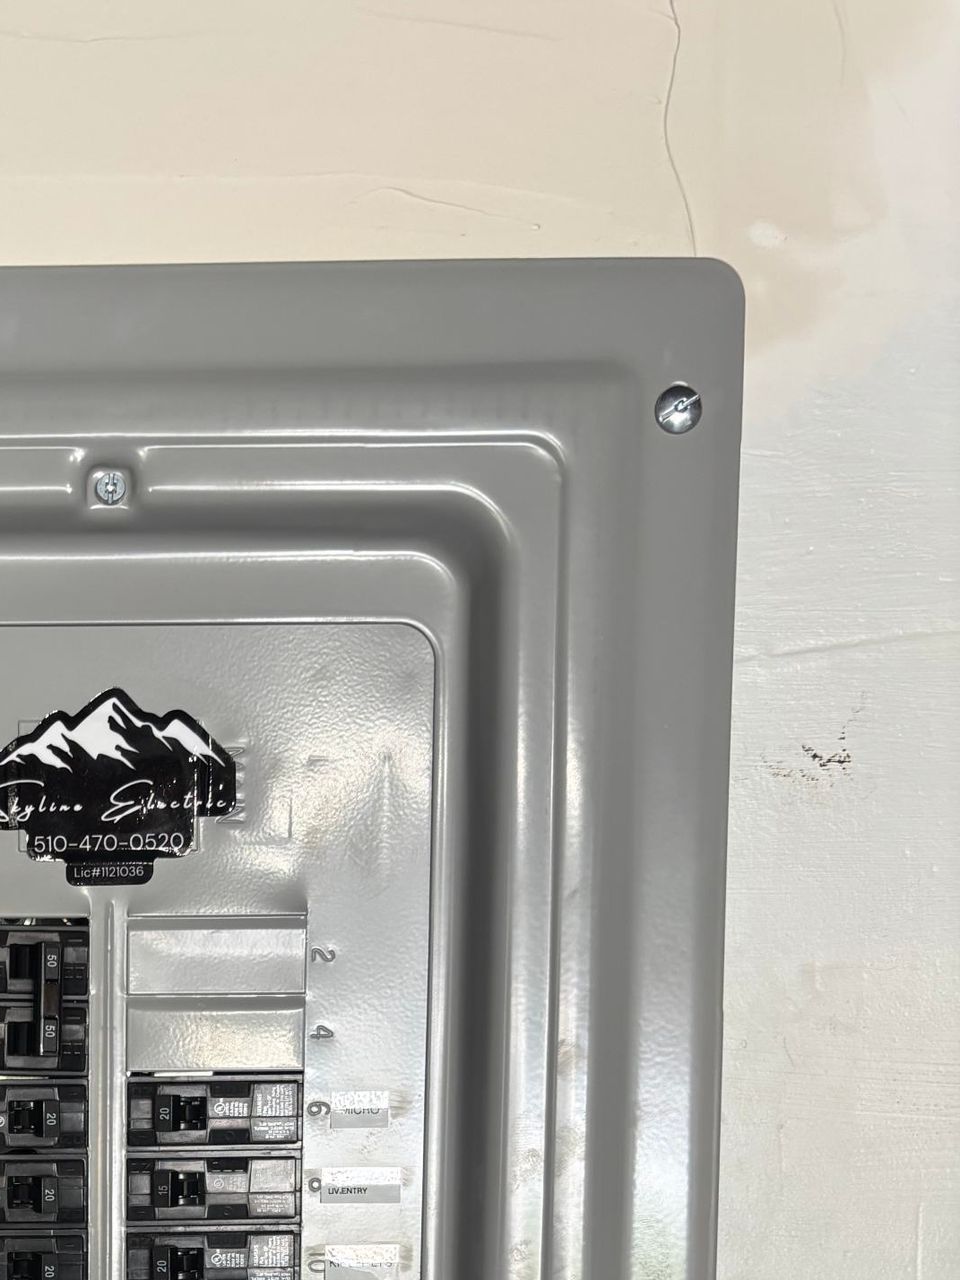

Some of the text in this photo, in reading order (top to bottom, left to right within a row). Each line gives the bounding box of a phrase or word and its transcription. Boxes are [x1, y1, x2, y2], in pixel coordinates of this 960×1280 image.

[34, 833, 184, 853] 510-470-0520
[74, 866, 144, 879] Lic#1121036
[47, 955, 57, 967] 50
[311, 947, 336, 963] 2
[46, 1025, 55, 1037] 50
[310, 1025, 334, 1040] 4
[159, 1107, 169, 1120] 20
[307, 1101, 331, 1116] 6
[47, 1113, 56, 1125] 20
[45, 1189, 54, 1201] 20
[158, 1185, 168, 1195] 15
[45, 1266, 54, 1277] 20
[157, 1261, 166, 1272] 20
